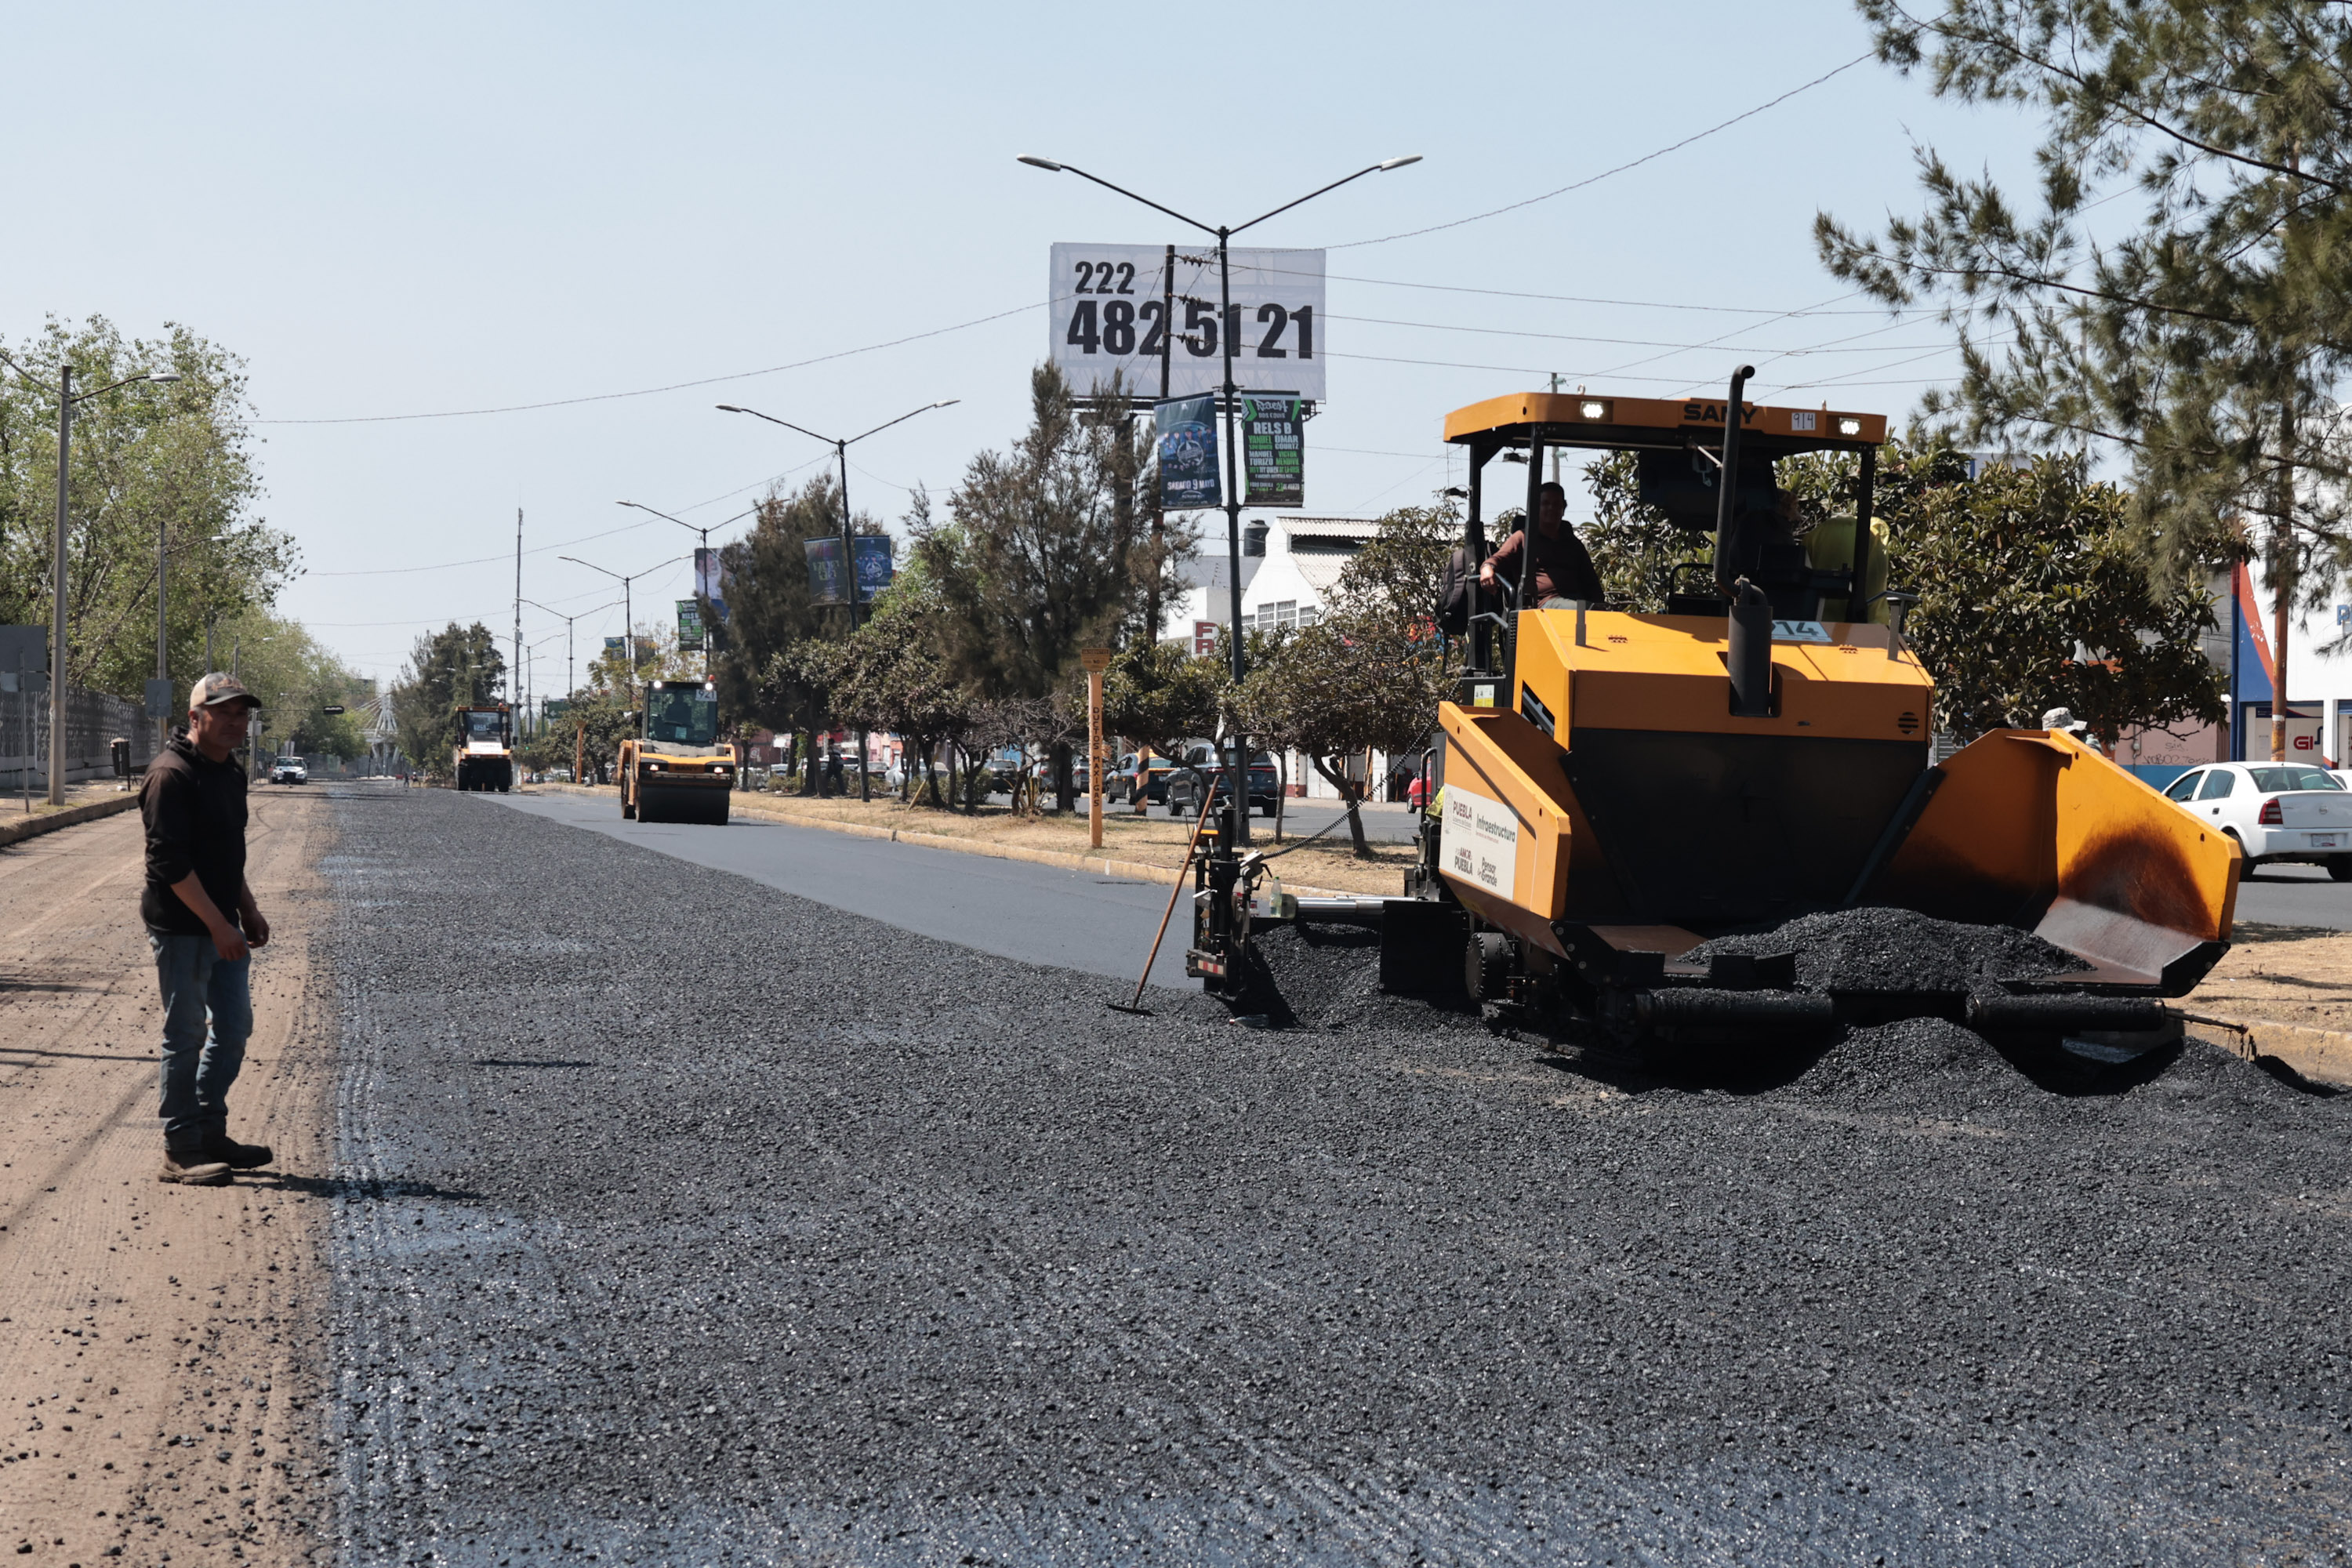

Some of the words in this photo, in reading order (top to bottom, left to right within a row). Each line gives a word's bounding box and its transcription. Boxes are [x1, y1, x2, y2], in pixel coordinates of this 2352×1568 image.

[1075, 261, 1134, 294] 222
[1067, 300, 1163, 355] 482
[1257, 303, 1312, 359] 21
[1684, 403, 1757, 424] SAY
[1793, 413, 1813, 429] 914
[1254, 422, 1282, 434] RELS
[1283, 422, 1292, 434] B
[1192, 478, 1198, 490] 9
[1199, 479, 1214, 488] MAYO
[699, 690, 716, 699] 921
[1453, 800, 1472, 820] PUEBLA
[1476, 813, 1515, 843] Infraestructura
[1454, 855, 1473, 876] PUEBLA
[1482, 856, 1497, 874] Pensar
[1481, 869, 1498, 887] Grande
